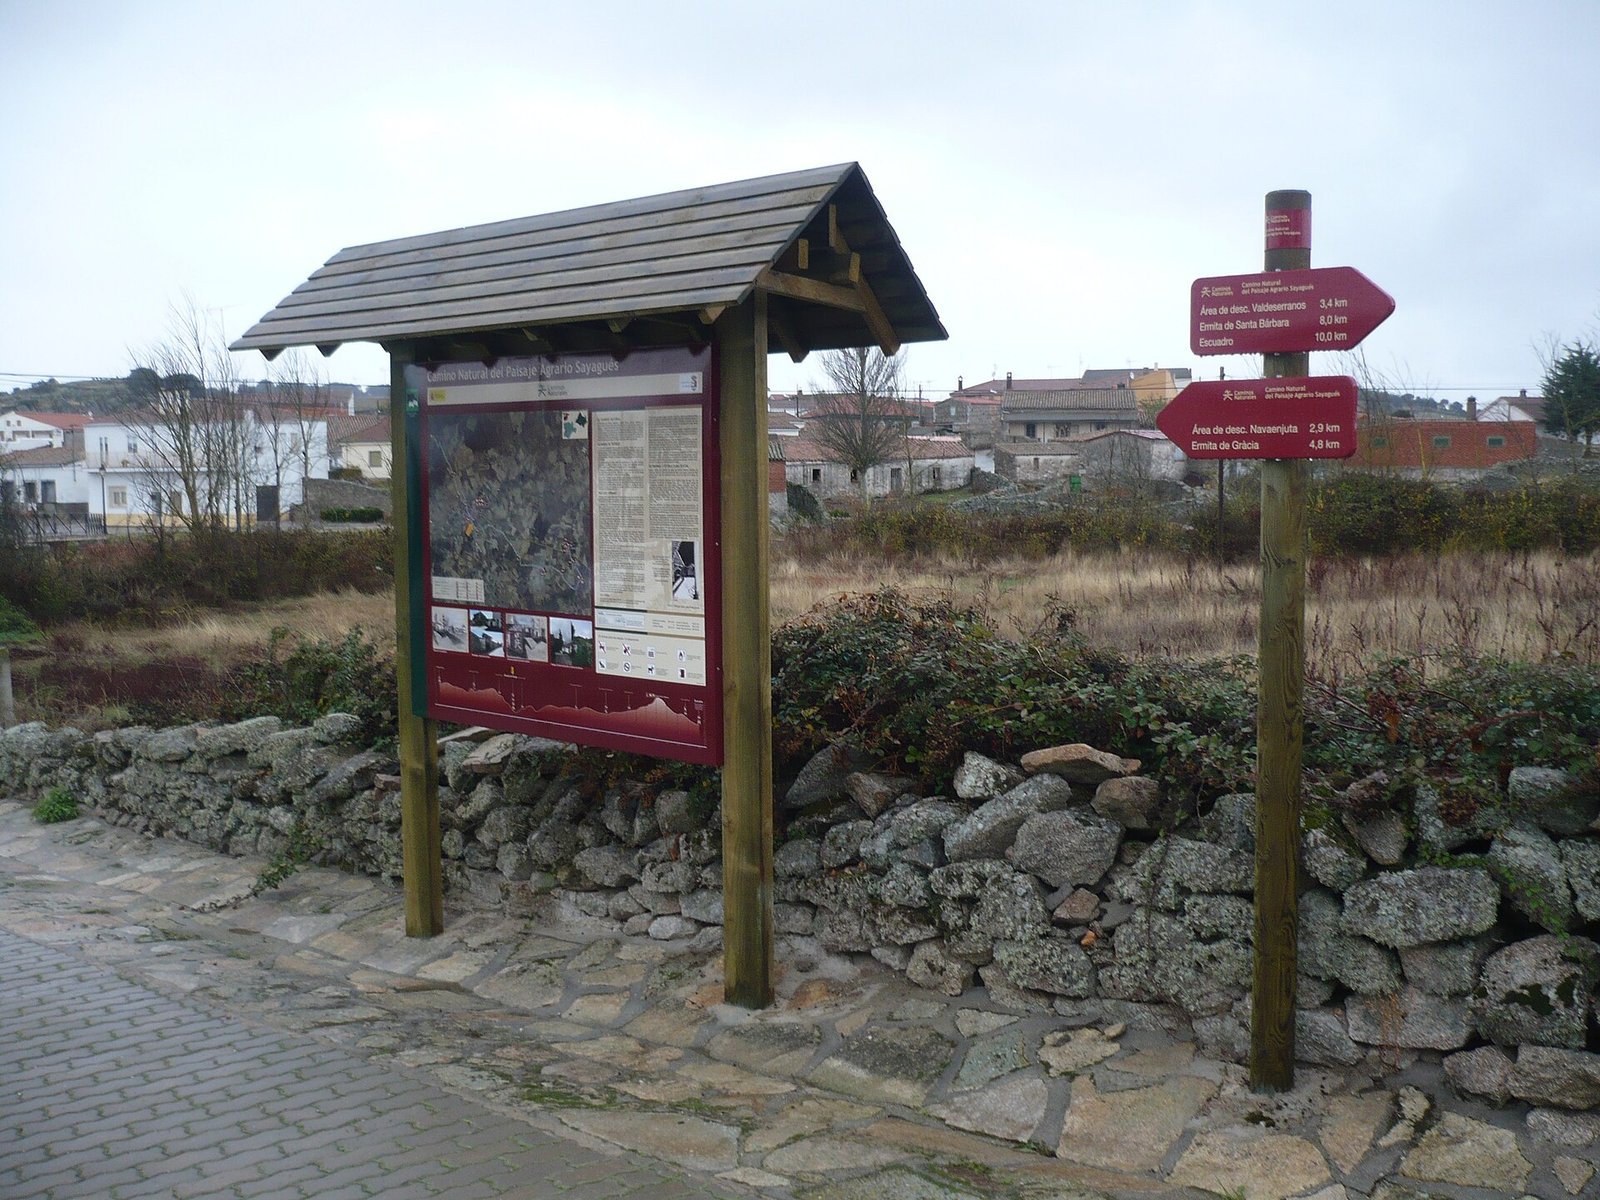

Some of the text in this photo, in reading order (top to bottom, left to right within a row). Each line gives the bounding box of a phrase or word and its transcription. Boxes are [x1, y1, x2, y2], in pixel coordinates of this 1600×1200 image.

[1200, 298, 1348, 316] Área de desc. Valdeserranos 3,4 km
[1199, 315, 1348, 332] Ermita de Santa Bárbara 8,0 km
[1199, 331, 1348, 348] Escuadro 10,0 km
[457, 366, 489, 381] Natural
[505, 364, 538, 379] Paisaje
[540, 360, 574, 378] Agrario
[574, 358, 619, 376] Sayagués
[1264, 392, 1274, 400] del
[1274, 391, 1294, 400] Paisaje
[1294, 391, 1314, 400] Agrario
[1285, 384, 1306, 392] Natural
[1191, 422, 1340, 436] Área de desc. Navaenjuta 2,9 km
[1191, 440, 1218, 451] Ermita
[1218, 440, 1230, 450] de
[1309, 439, 1324, 451] 4,8
[1325, 439, 1340, 449] km
